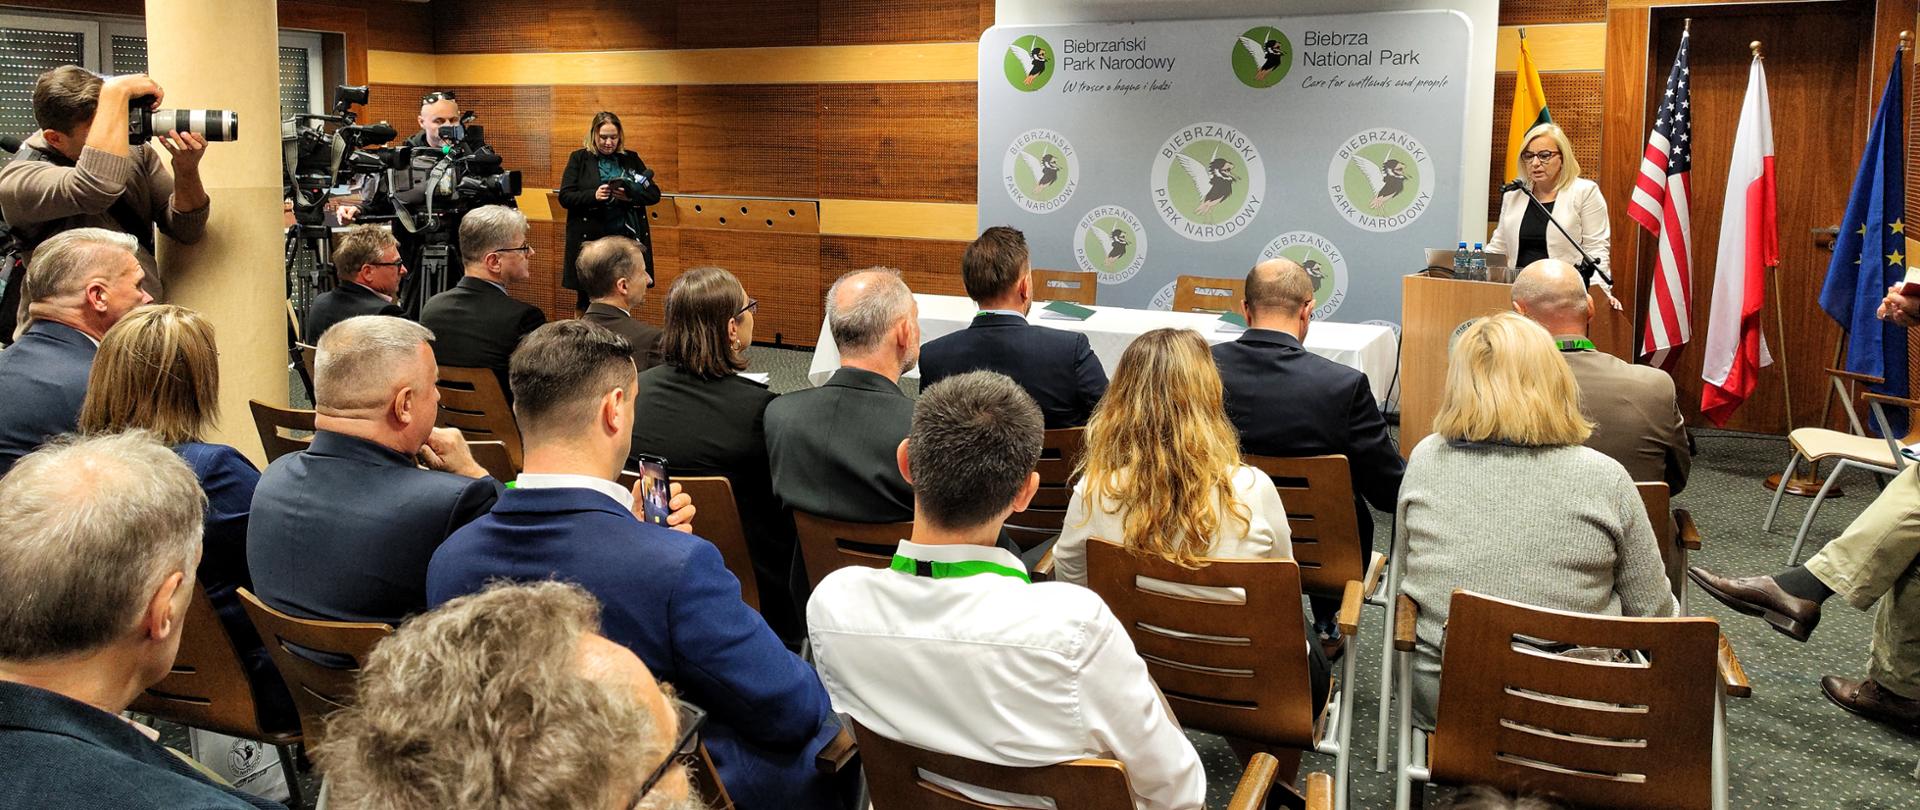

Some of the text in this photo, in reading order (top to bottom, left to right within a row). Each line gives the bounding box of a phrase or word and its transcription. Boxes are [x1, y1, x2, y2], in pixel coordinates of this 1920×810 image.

[1063, 36, 1146, 54] Biebrzański
[1304, 31, 1369, 46] Biebrza
[1063, 55, 1175, 72] Park Narodowy
[1303, 49, 1420, 67] National Park
[1062, 80, 1077, 94] W
[1078, 81, 1105, 93] trosce
[1149, 79, 1173, 92] ludzi
[1301, 75, 1448, 92] Care for wetlands and people
[1162, 126, 1256, 162] BIEBRZAŃSKI
[1005, 175, 1076, 211] PARK NARODOWY
[1155, 188, 1260, 237] PARK NARODOWY
[1332, 184, 1430, 228] PARK NARODOWY
[1077, 248, 1094, 272] PARK
